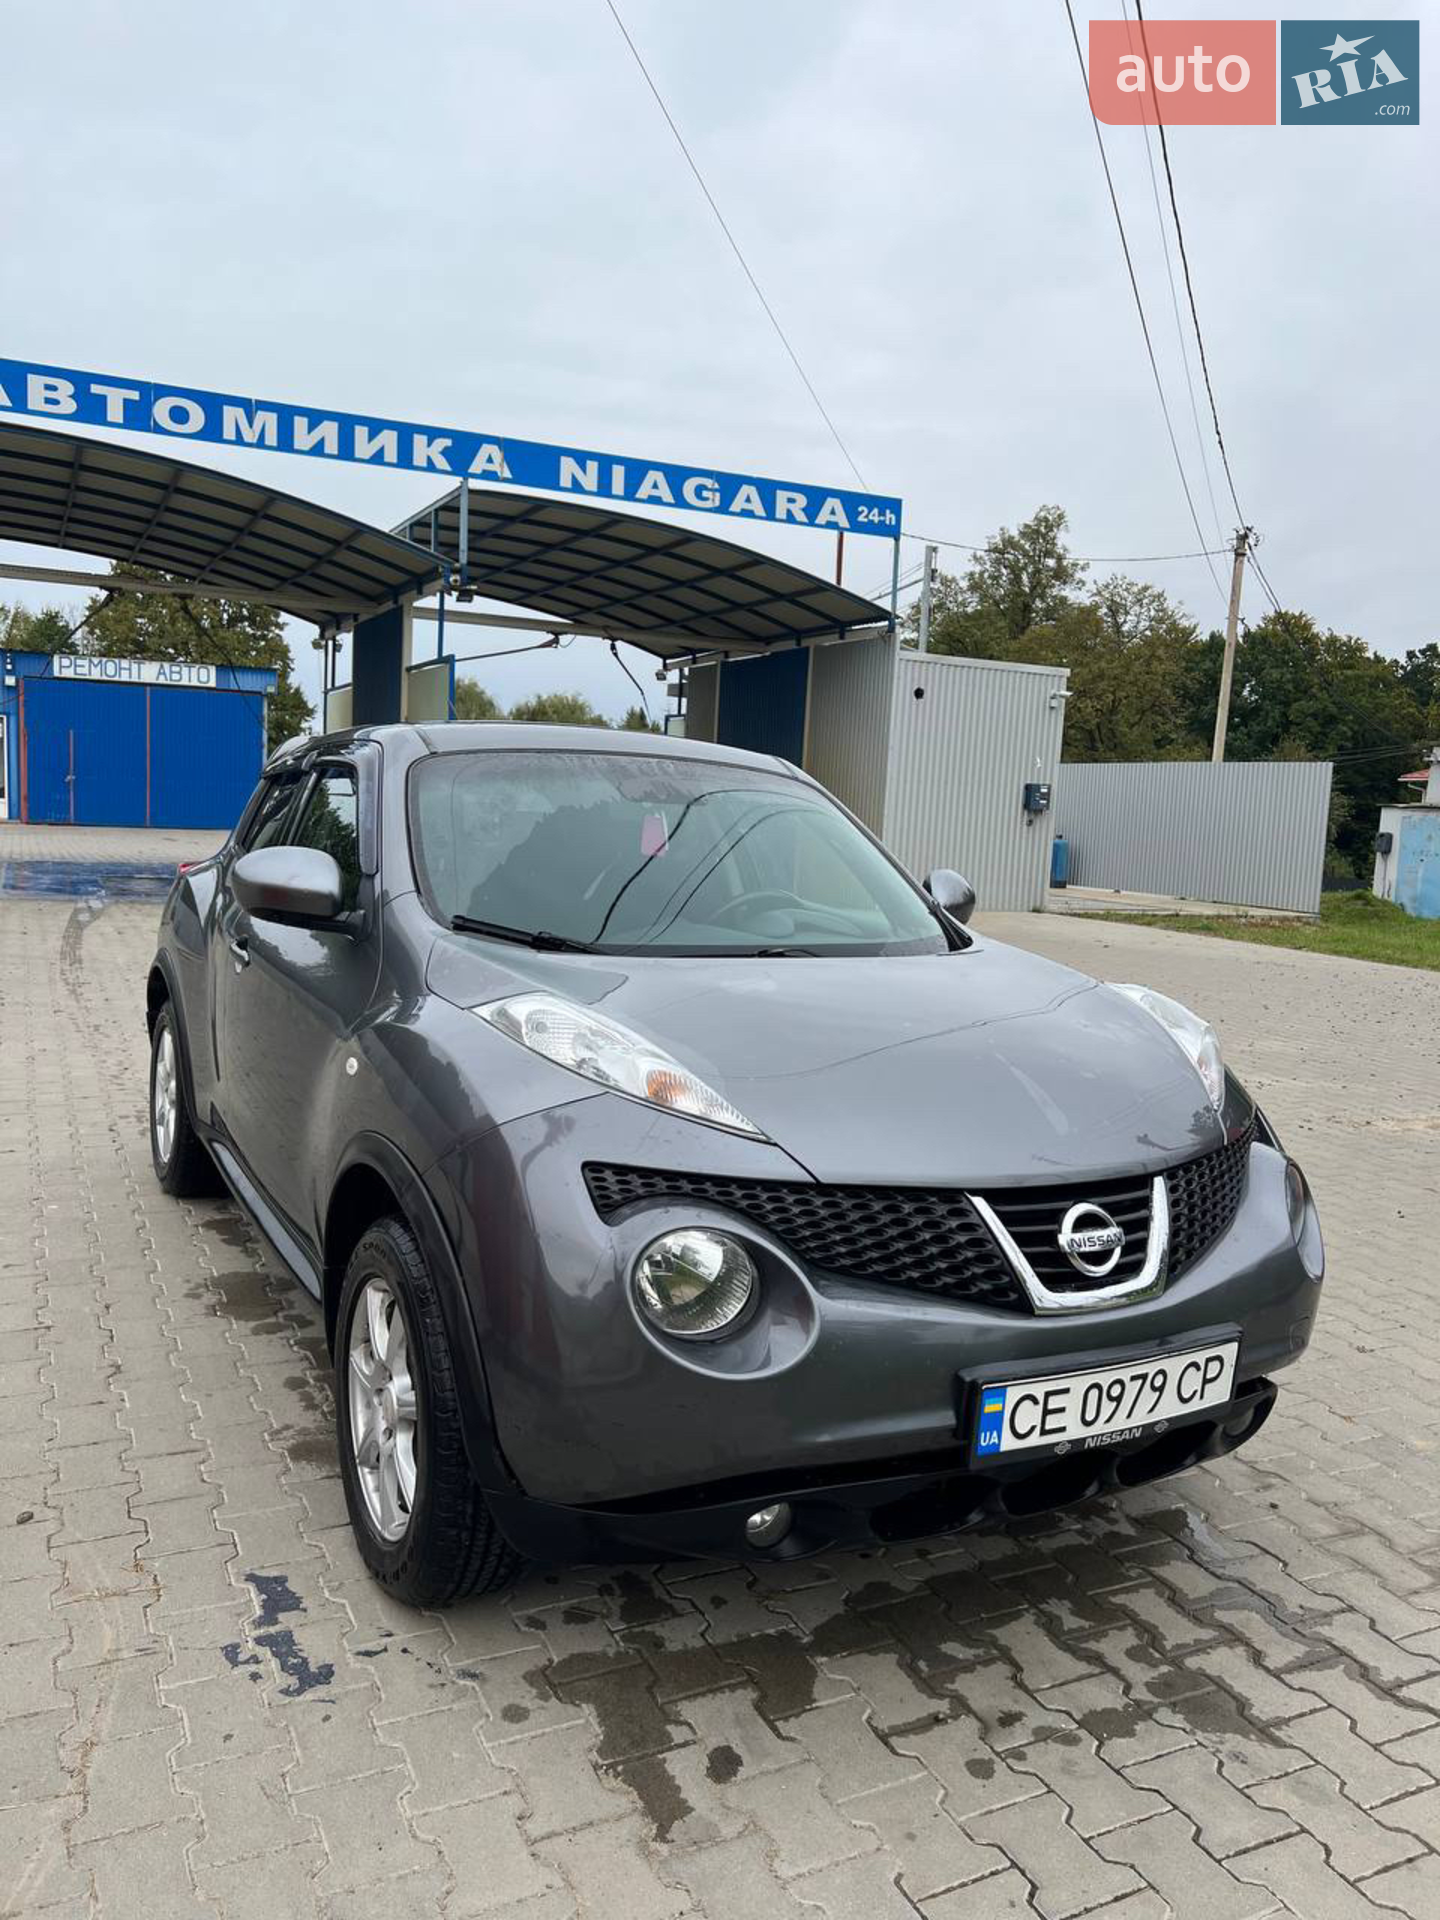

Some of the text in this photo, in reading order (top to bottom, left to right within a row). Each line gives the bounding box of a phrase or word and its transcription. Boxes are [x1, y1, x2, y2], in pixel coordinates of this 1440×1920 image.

[559, 455, 850, 529] NIAGARA
[857, 505, 897, 526] 24-h
[58, 656, 211, 684] РЕМОНТ АВТО
[1069, 1232, 1123, 1249] NISSAN
[1008, 1354, 1225, 1439] CE 0979 CP
[980, 1431, 999, 1446] UA
[1084, 1427, 1143, 1449] NISSAN
